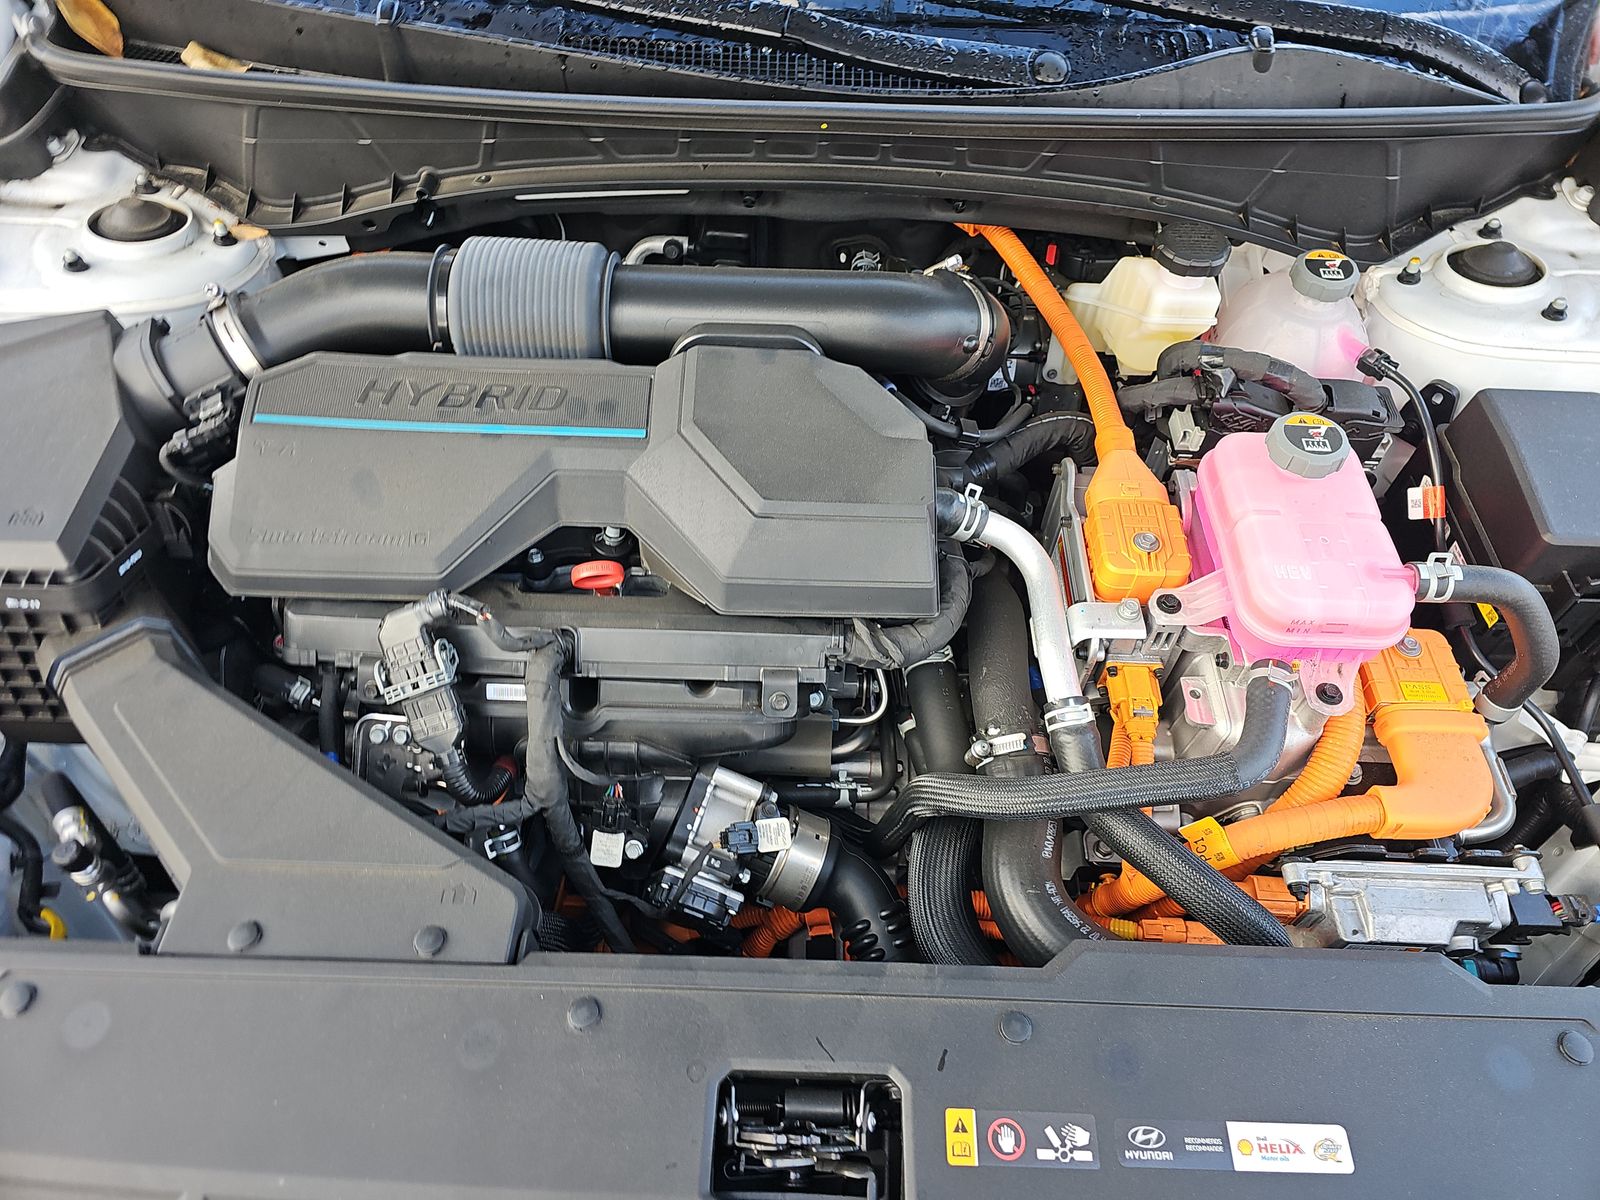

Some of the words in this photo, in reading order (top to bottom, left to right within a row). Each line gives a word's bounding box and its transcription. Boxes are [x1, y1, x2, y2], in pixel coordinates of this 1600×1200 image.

[354, 378, 568, 413] HYBRID
[1257, 1143, 1303, 1155] HELIX
[1125, 1150, 1174, 1161] HYUNDAI
